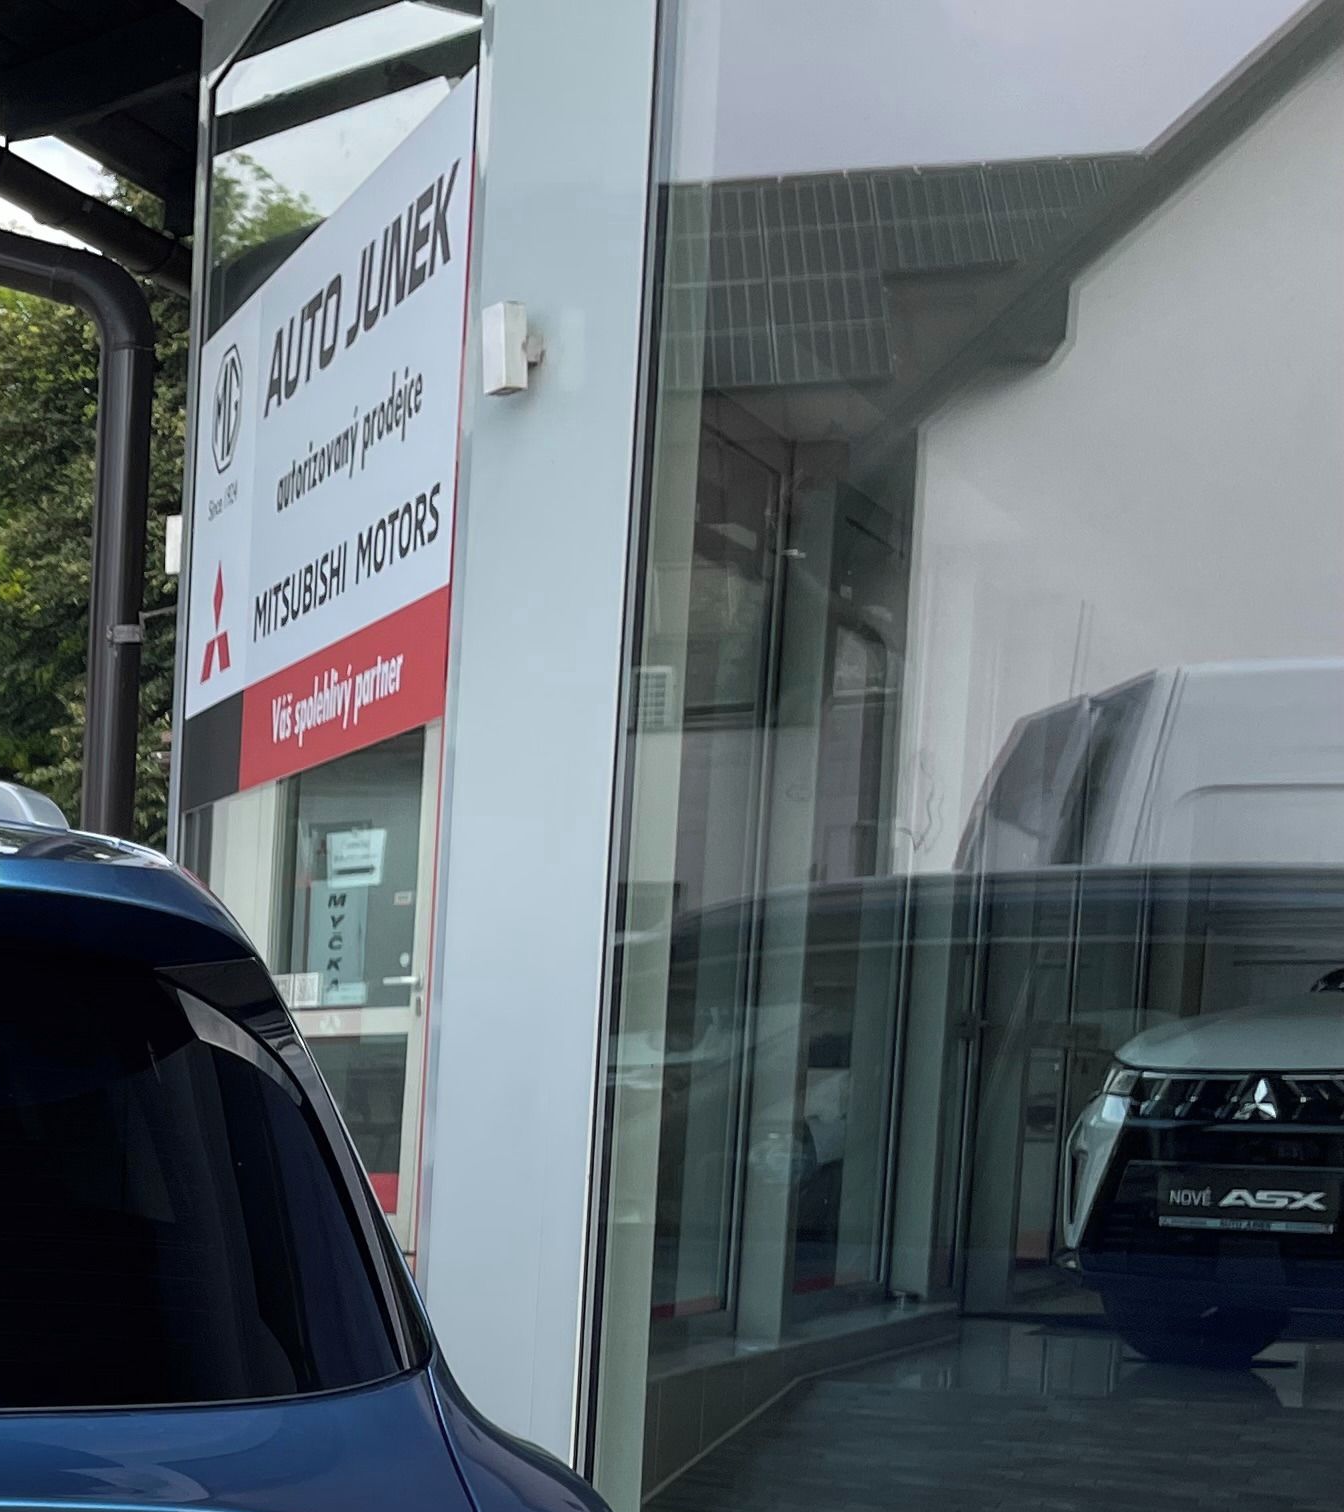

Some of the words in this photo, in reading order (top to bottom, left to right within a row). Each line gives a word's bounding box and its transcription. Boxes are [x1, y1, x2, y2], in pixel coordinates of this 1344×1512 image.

[264, 273, 342, 419] AUTO
[344, 158, 461, 349] JUNEK
[277, 405, 359, 513] autorizovaný
[361, 366, 423, 471] prodejce
[253, 541, 347, 643] MITSUBISHI
[355, 482, 441, 585] MOTORS
[272, 693, 293, 744] Váš
[294, 664, 353, 748] spolehlivý
[353, 654, 404, 725] partner
[1169, 1186, 1211, 1207] NOVÉ
[1218, 1189, 1327, 1211] ASX
